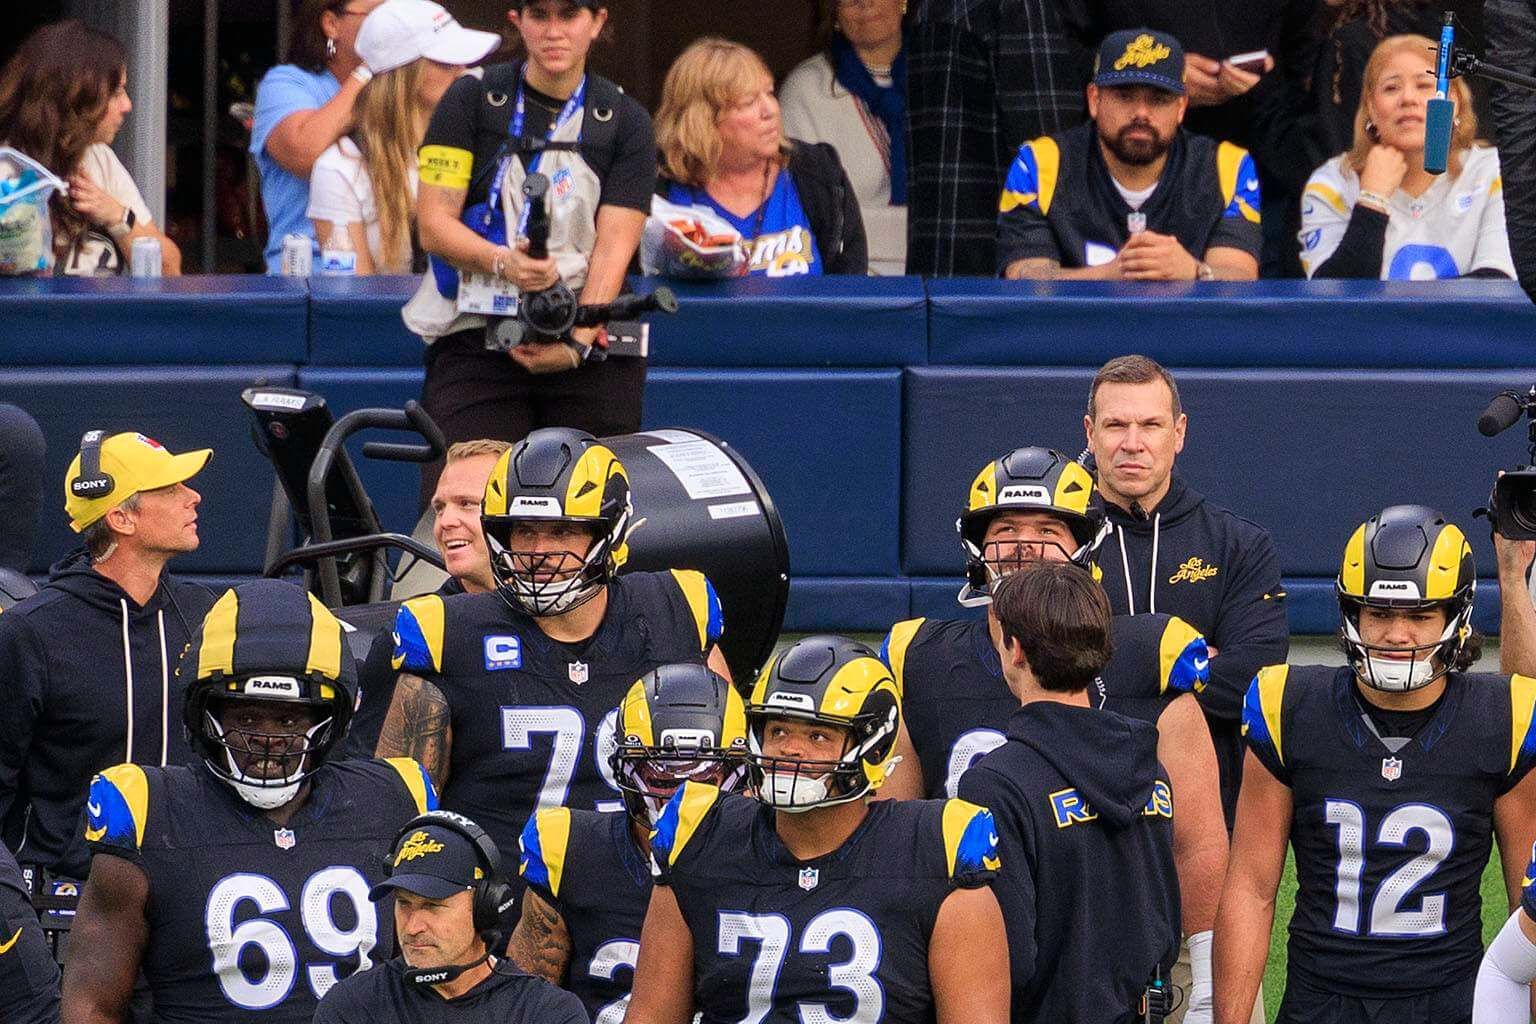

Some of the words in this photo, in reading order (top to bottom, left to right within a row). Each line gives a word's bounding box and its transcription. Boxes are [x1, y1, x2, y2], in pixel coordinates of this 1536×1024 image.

[73, 479, 107, 490] SONY
[486, 637, 519, 661] C
[253, 681, 292, 690] RAMS
[776, 694, 803, 702] RAMS
[1049, 780, 1173, 828] RS
[1324, 800, 1454, 936] 12
[205, 865, 379, 1010] 69
[415, 972, 448, 983] SONY
